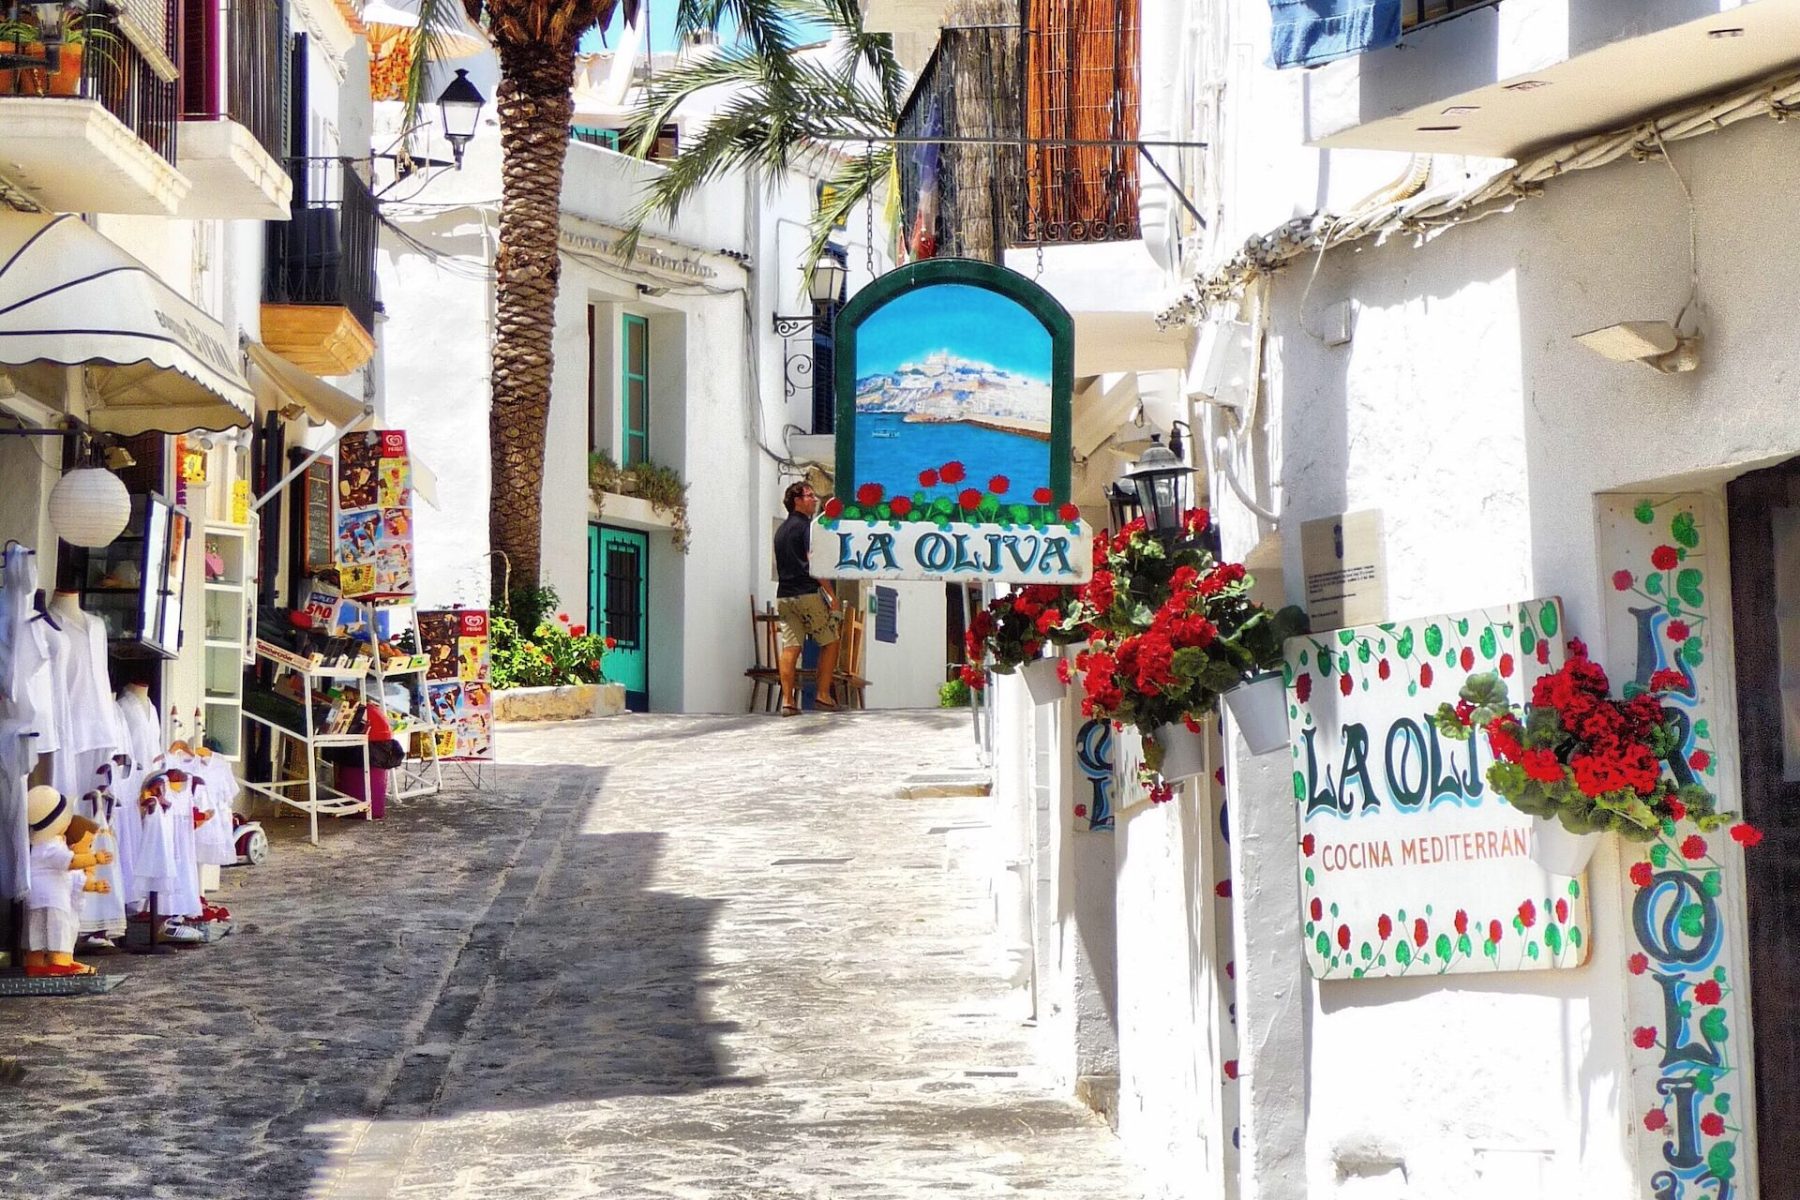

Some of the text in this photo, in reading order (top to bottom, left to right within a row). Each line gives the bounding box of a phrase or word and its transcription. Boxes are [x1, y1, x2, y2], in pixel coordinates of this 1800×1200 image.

[836, 532, 1077, 575] LA OLIVA
[1302, 721, 1381, 822] LA
[1322, 826, 1533, 872] COCINA MEDITERRÁN
